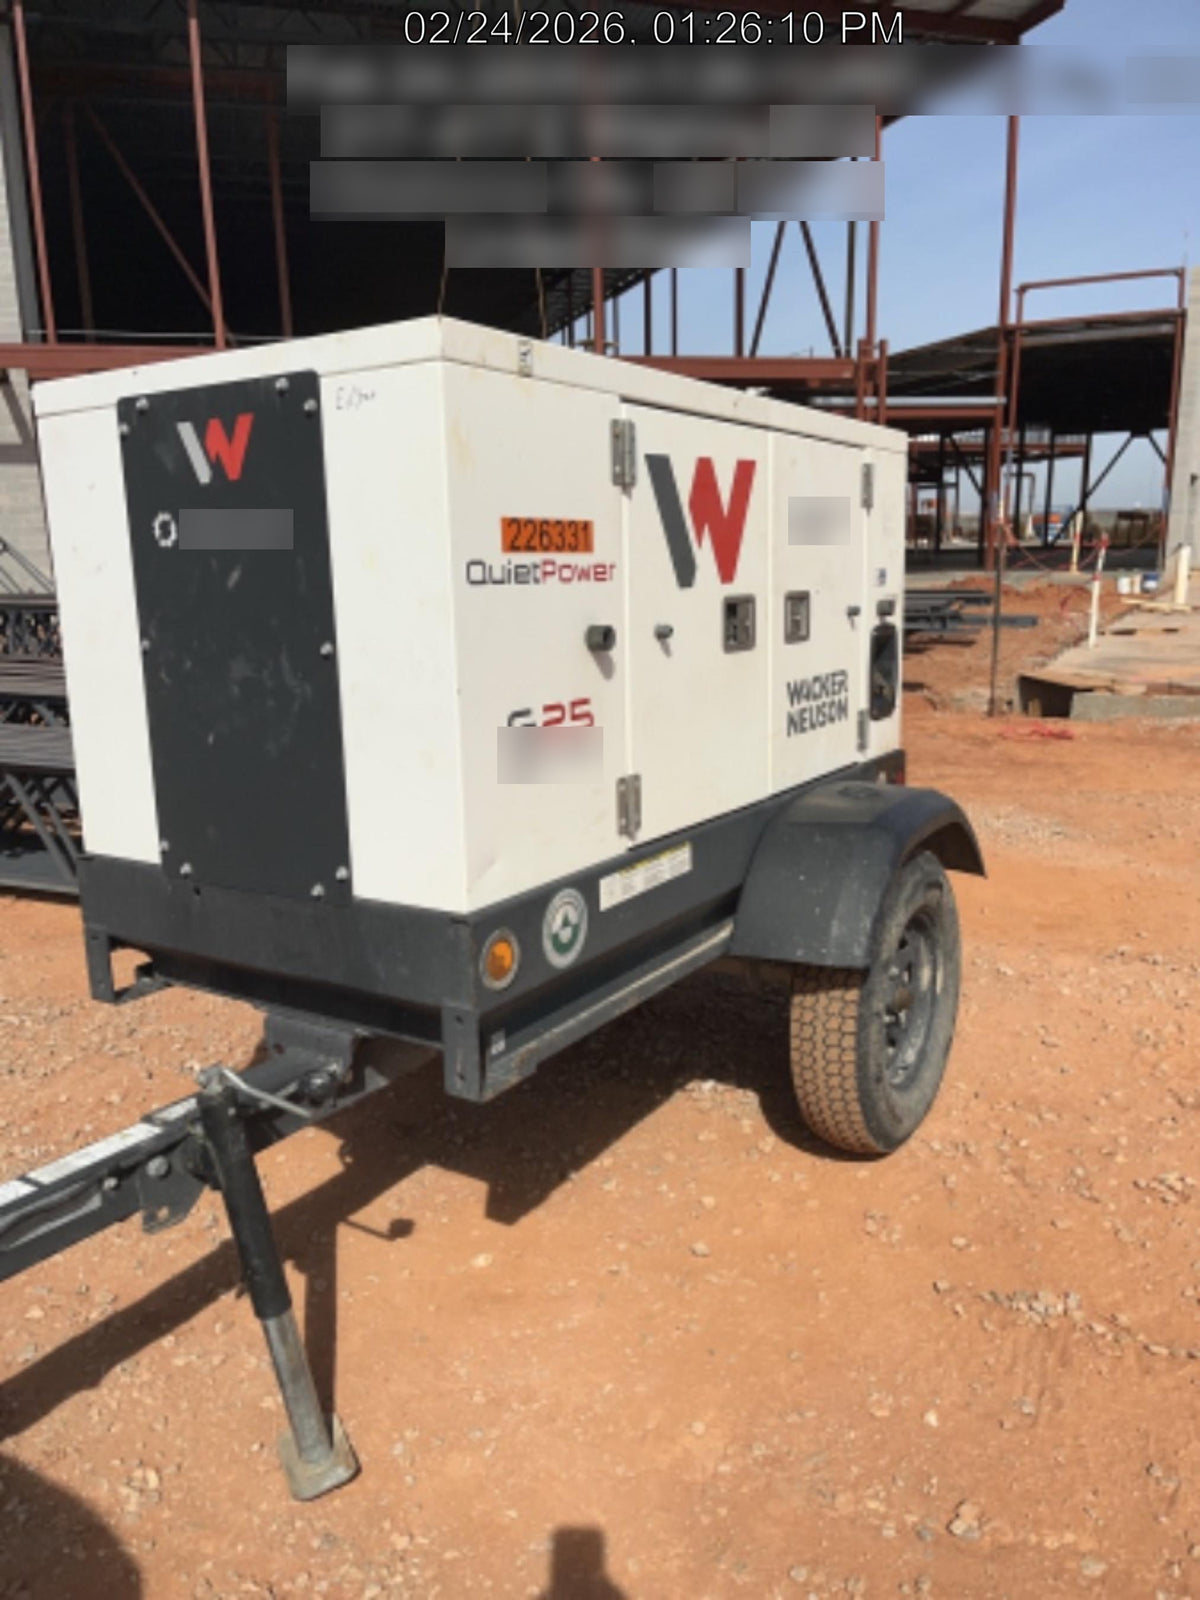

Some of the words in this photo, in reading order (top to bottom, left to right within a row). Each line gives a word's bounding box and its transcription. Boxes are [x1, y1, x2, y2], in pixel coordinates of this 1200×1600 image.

[507, 516, 589, 552] 226331
[465, 557, 616, 586] QuietPower
[786, 668, 848, 708] WACKER
[786, 698, 848, 738] NEUSON
